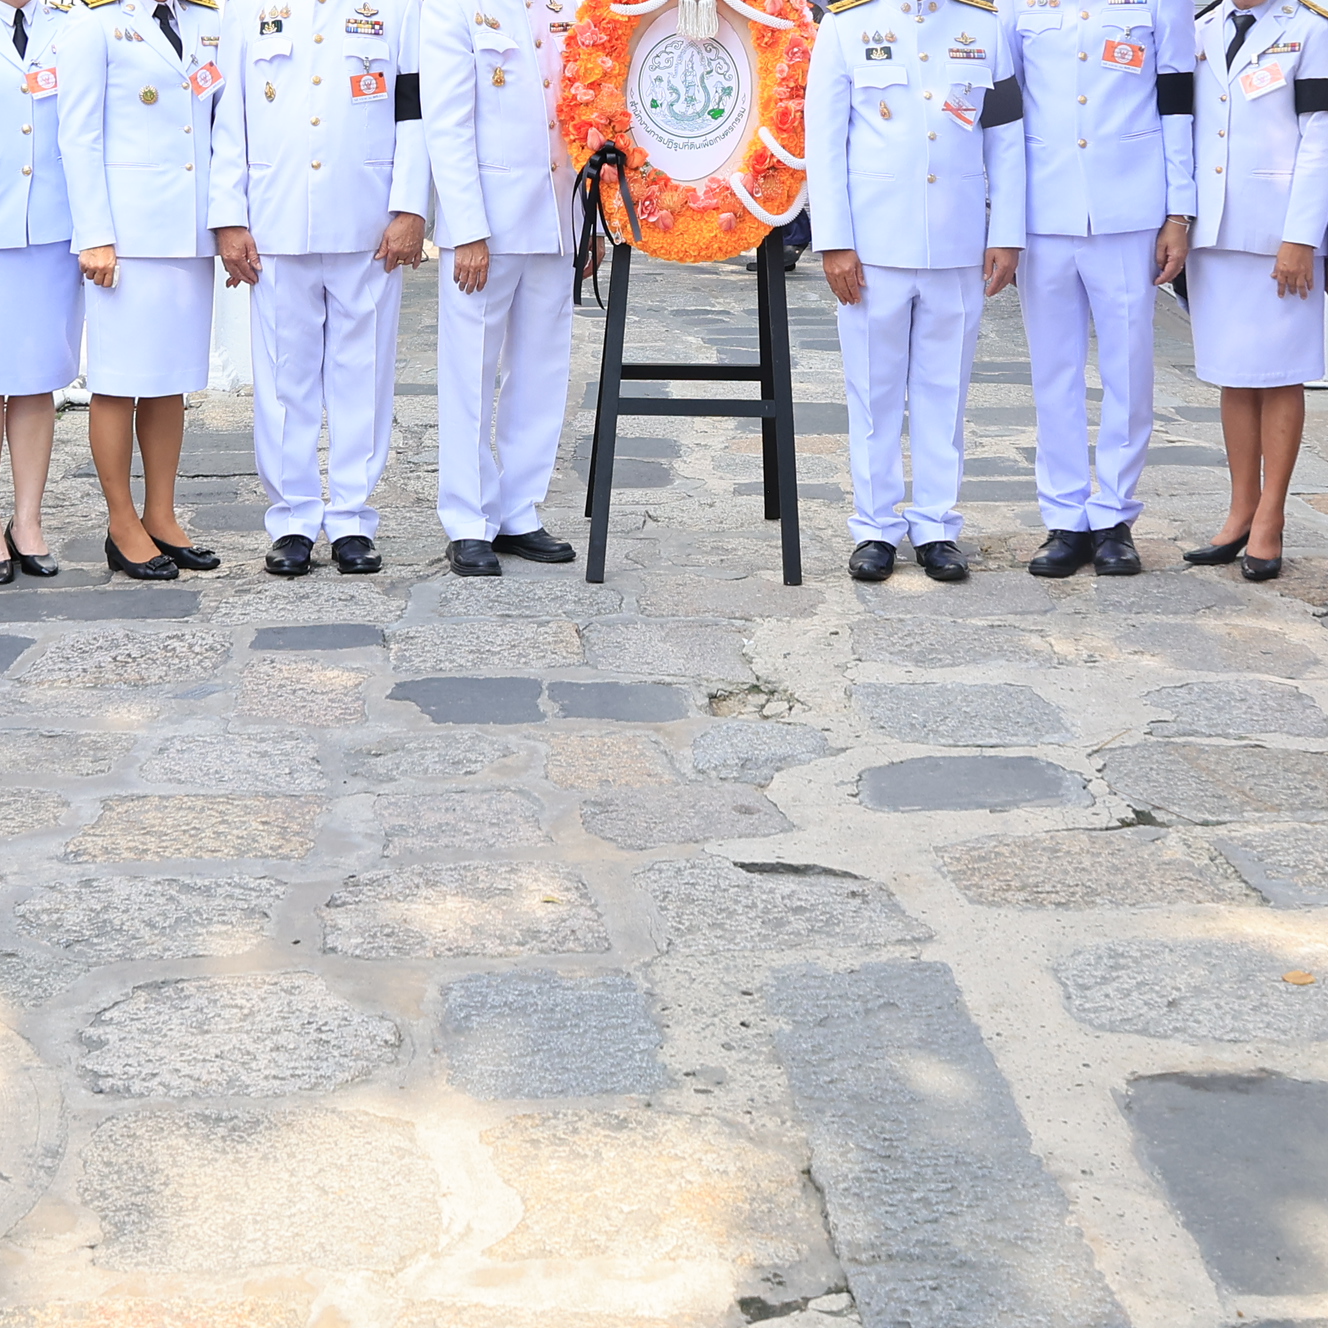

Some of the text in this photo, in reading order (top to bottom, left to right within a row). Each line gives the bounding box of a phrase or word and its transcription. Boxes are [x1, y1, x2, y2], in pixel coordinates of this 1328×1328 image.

[629, 100, 747, 152] สำนักงานการปฏิรูปที่ดินเพื่อเกษตรกรรม
